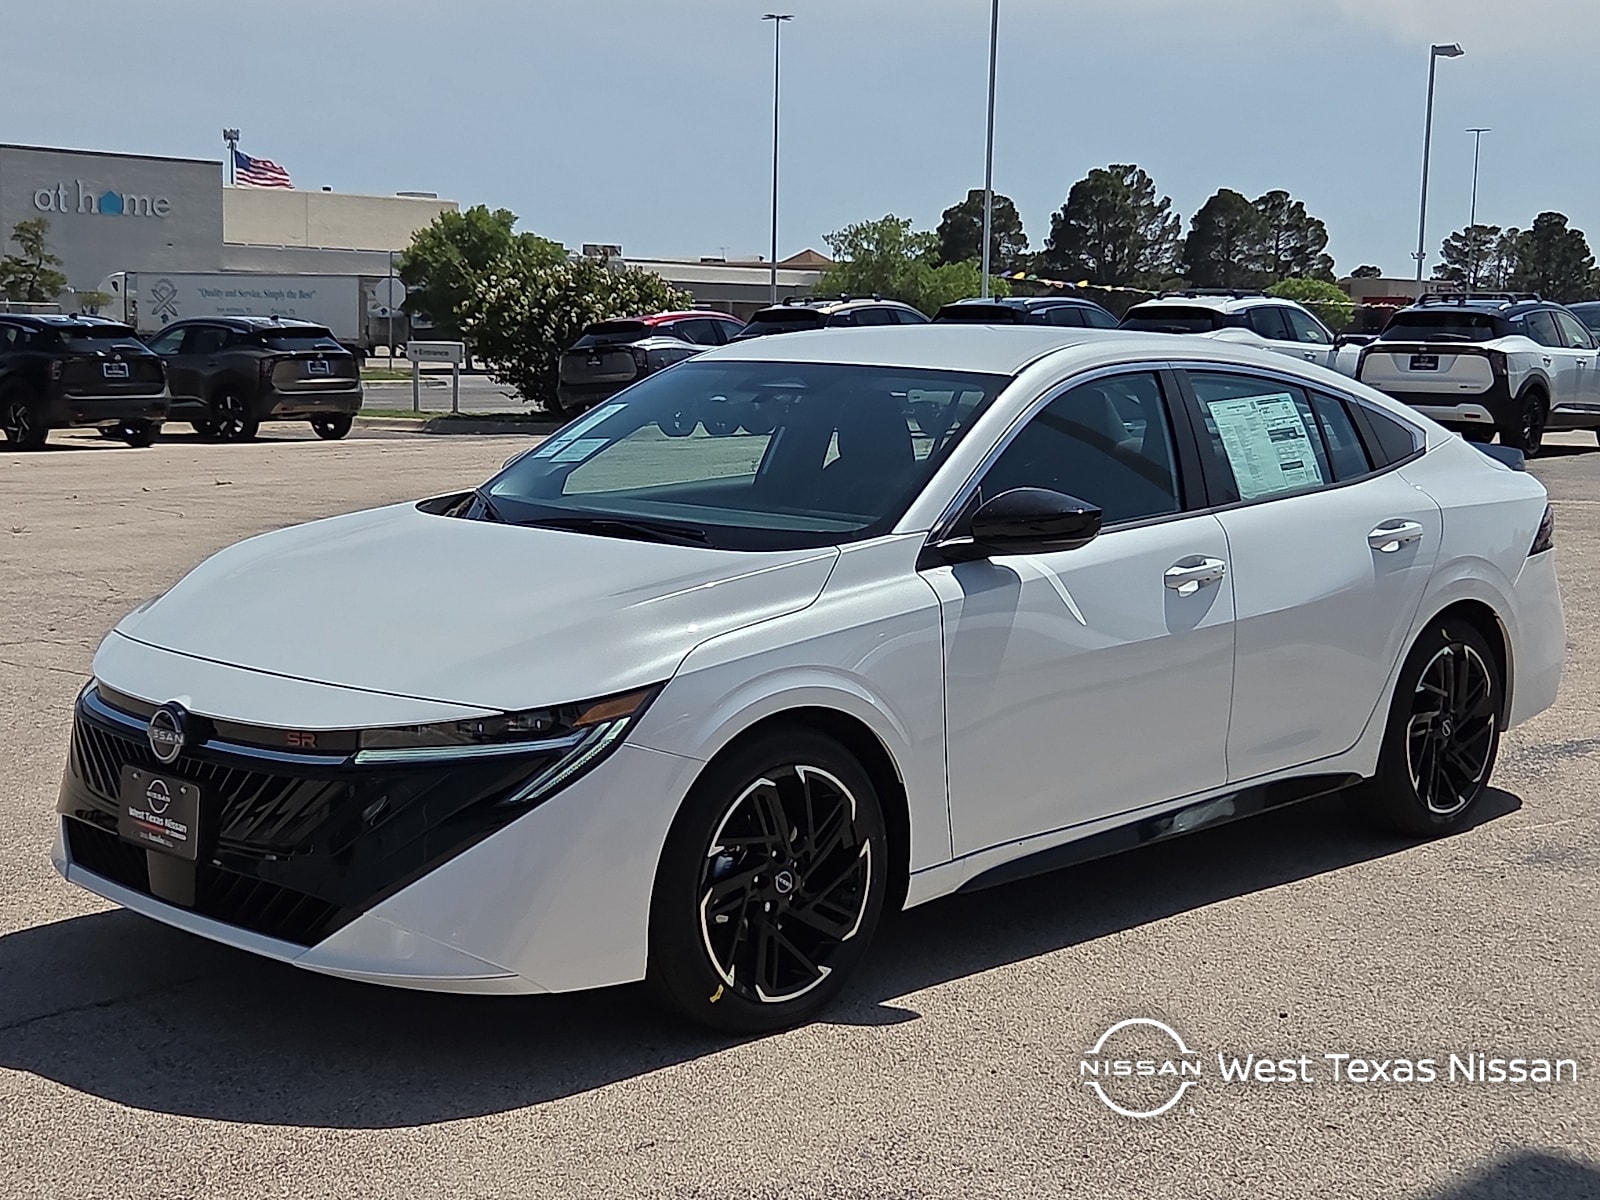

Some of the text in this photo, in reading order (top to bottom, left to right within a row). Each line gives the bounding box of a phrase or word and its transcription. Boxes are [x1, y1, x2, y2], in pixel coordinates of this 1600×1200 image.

[33, 182, 68, 213] at
[225, 288, 237, 297] and
[286, 289, 297, 298] the
[419, 348, 449, 357] Entrance
[287, 731, 316, 748] SR
[128, 806, 187, 834] West Texas Nissan
